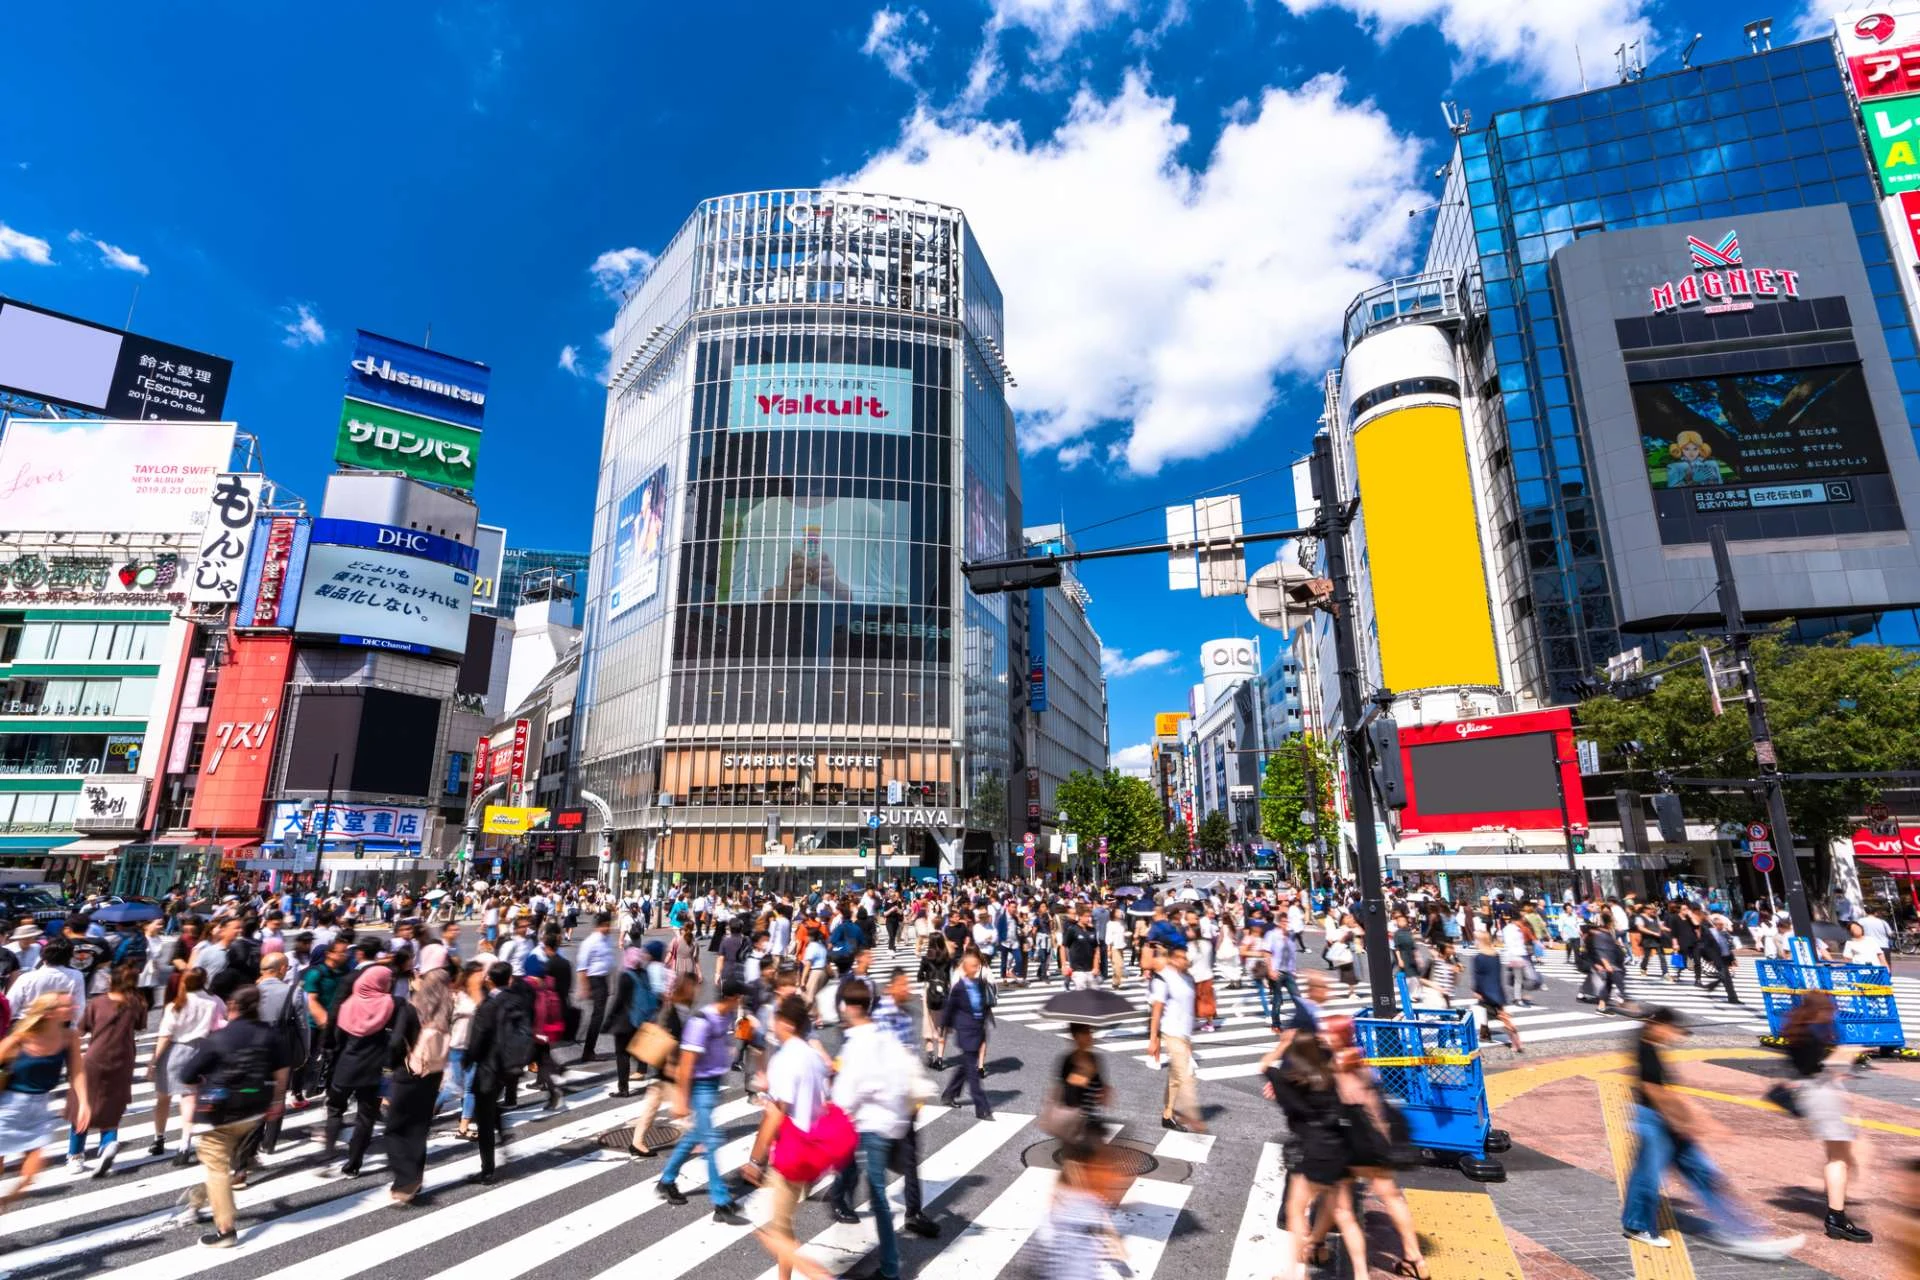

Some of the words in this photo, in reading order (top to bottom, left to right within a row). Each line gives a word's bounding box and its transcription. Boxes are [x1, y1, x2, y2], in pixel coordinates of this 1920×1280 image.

[1875, 110, 1920, 139] レ
[1650, 268, 1799, 313] MAGNET
[139, 354, 212, 384] 鈴木愛理
[352, 355, 485, 406] Hisamitsu
[170, 400, 184, 409] On
[185, 404, 206, 415] Sale
[754, 394, 890, 418] Yakult
[347, 419, 471, 468] サロンパス
[132, 476, 152, 484] NEW
[154, 476, 184, 484] ALBUM
[135, 464, 178, 475] TAYLOR
[182, 465, 218, 475] SWIFT
[196, 476, 255, 598] もんじゃ
[377, 528, 429, 552] DHC
[347, 561, 410, 579] どこよりも
[333, 571, 460, 610] 優れていなければ
[474, 577, 493, 597] 21
[315, 583, 428, 622] 製品化しない。
[362, 638, 381, 646] DHC
[381, 640, 412, 651] Channel
[206, 708, 277, 775] クスリ
[512, 726, 526, 770] カラオケ
[34, 765, 57, 775] DARTS
[724, 753, 816, 768] STARBUCKS
[825, 755, 882, 768] COFFEE
[283, 810, 419, 835] 大盛堂書店
[863, 809, 948, 825] TSUTAYA
